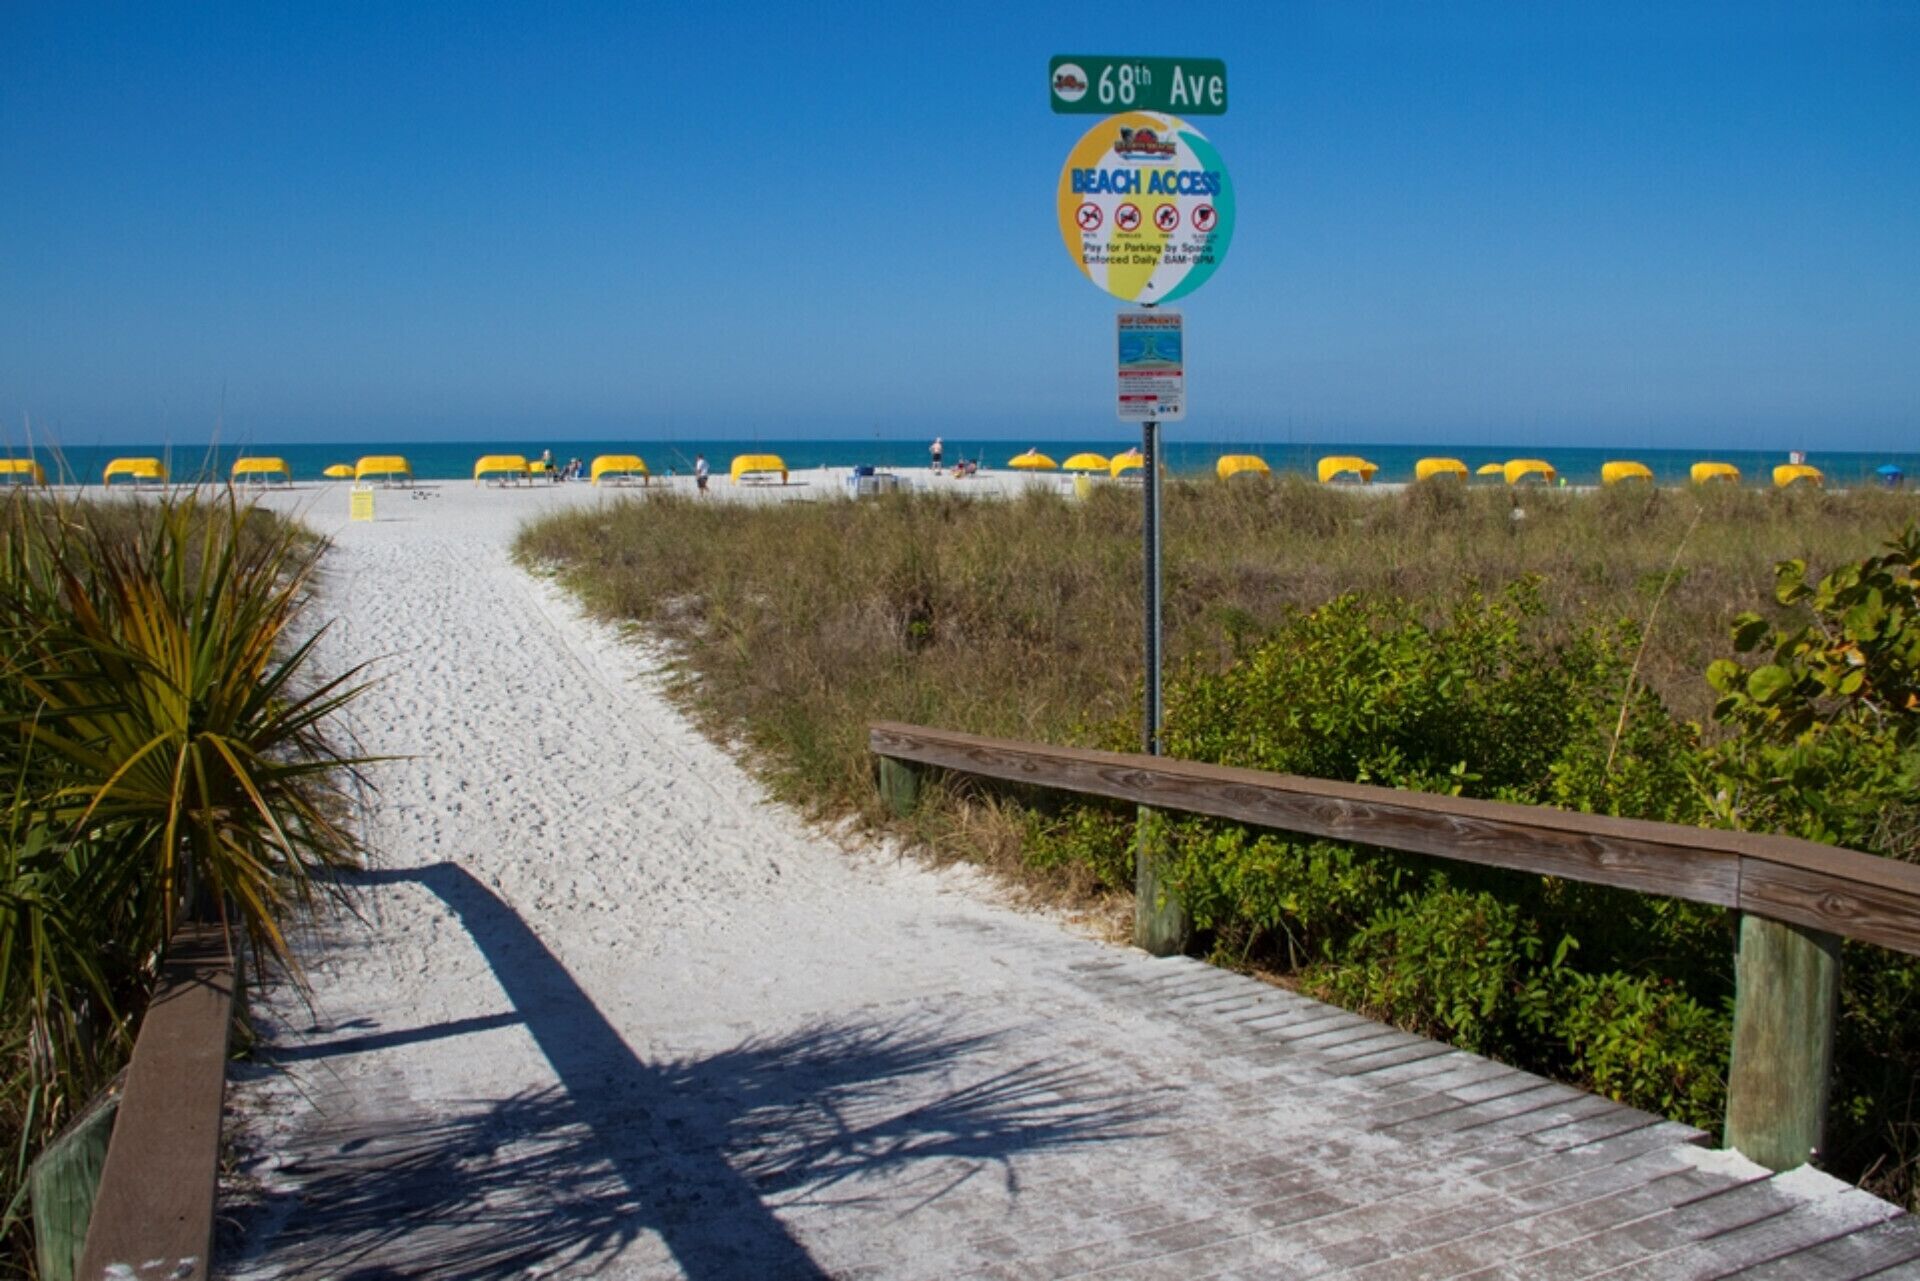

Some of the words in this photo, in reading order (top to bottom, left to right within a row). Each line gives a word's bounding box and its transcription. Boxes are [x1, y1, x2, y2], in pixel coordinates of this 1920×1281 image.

[1098, 64, 1151, 105] 68th
[1170, 65, 1223, 106] Ave
[1072, 168, 1141, 194] BEACH
[1148, 170, 1221, 196] ACCESS
[1084, 242, 1102, 254] Pay
[1106, 242, 1120, 252] for
[1124, 243, 1161, 254] Parking
[1165, 243, 1178, 255] by
[1182, 243, 1213, 255] Space
[1083, 255, 1129, 265] Enforced
